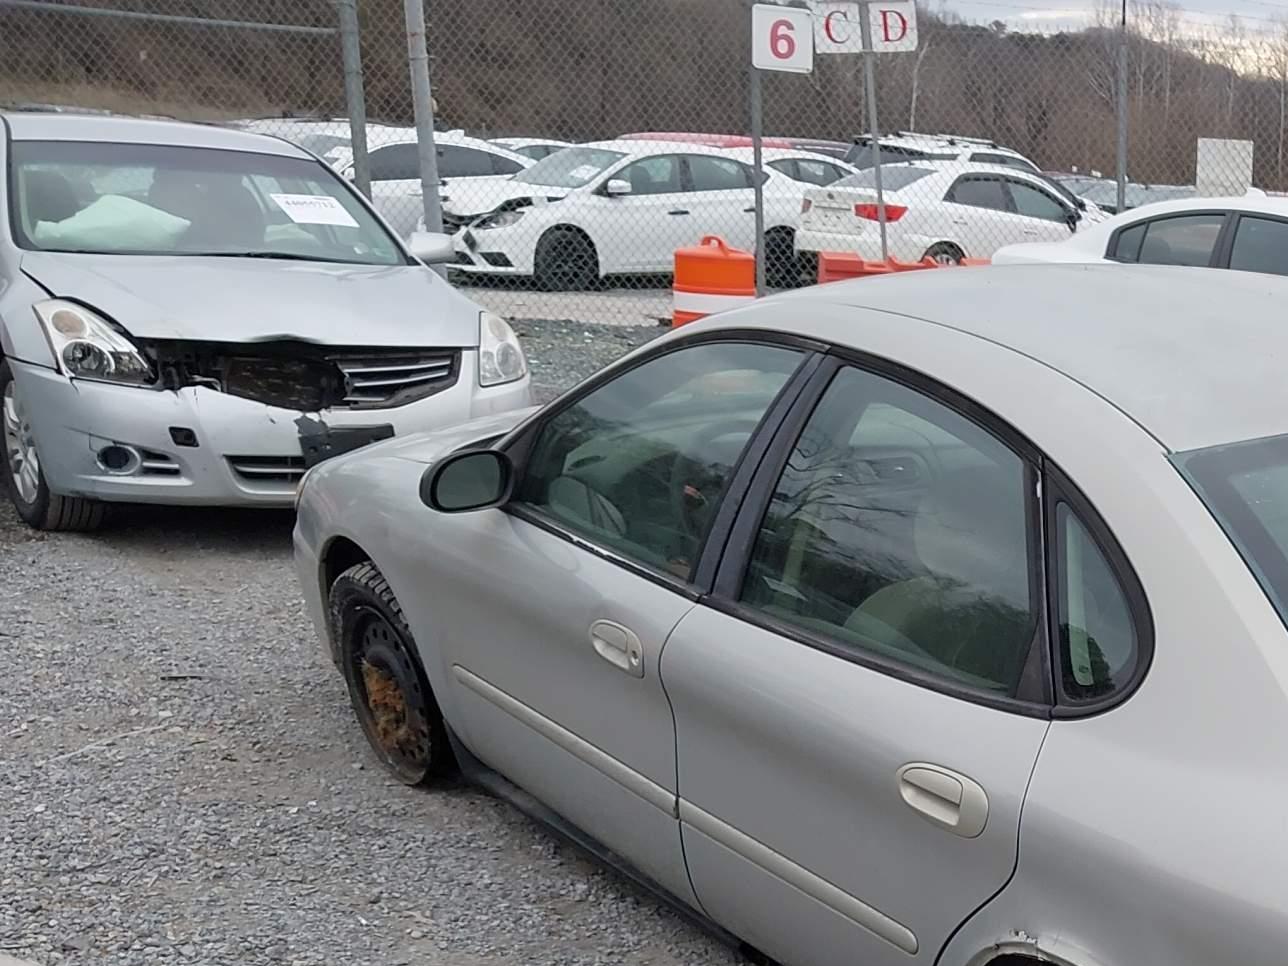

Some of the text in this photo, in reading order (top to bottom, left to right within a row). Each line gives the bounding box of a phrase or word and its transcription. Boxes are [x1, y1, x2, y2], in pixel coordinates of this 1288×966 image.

[770, 19, 795, 59] 6
[825, 10, 849, 44] C
[879, 10, 907, 42] D
